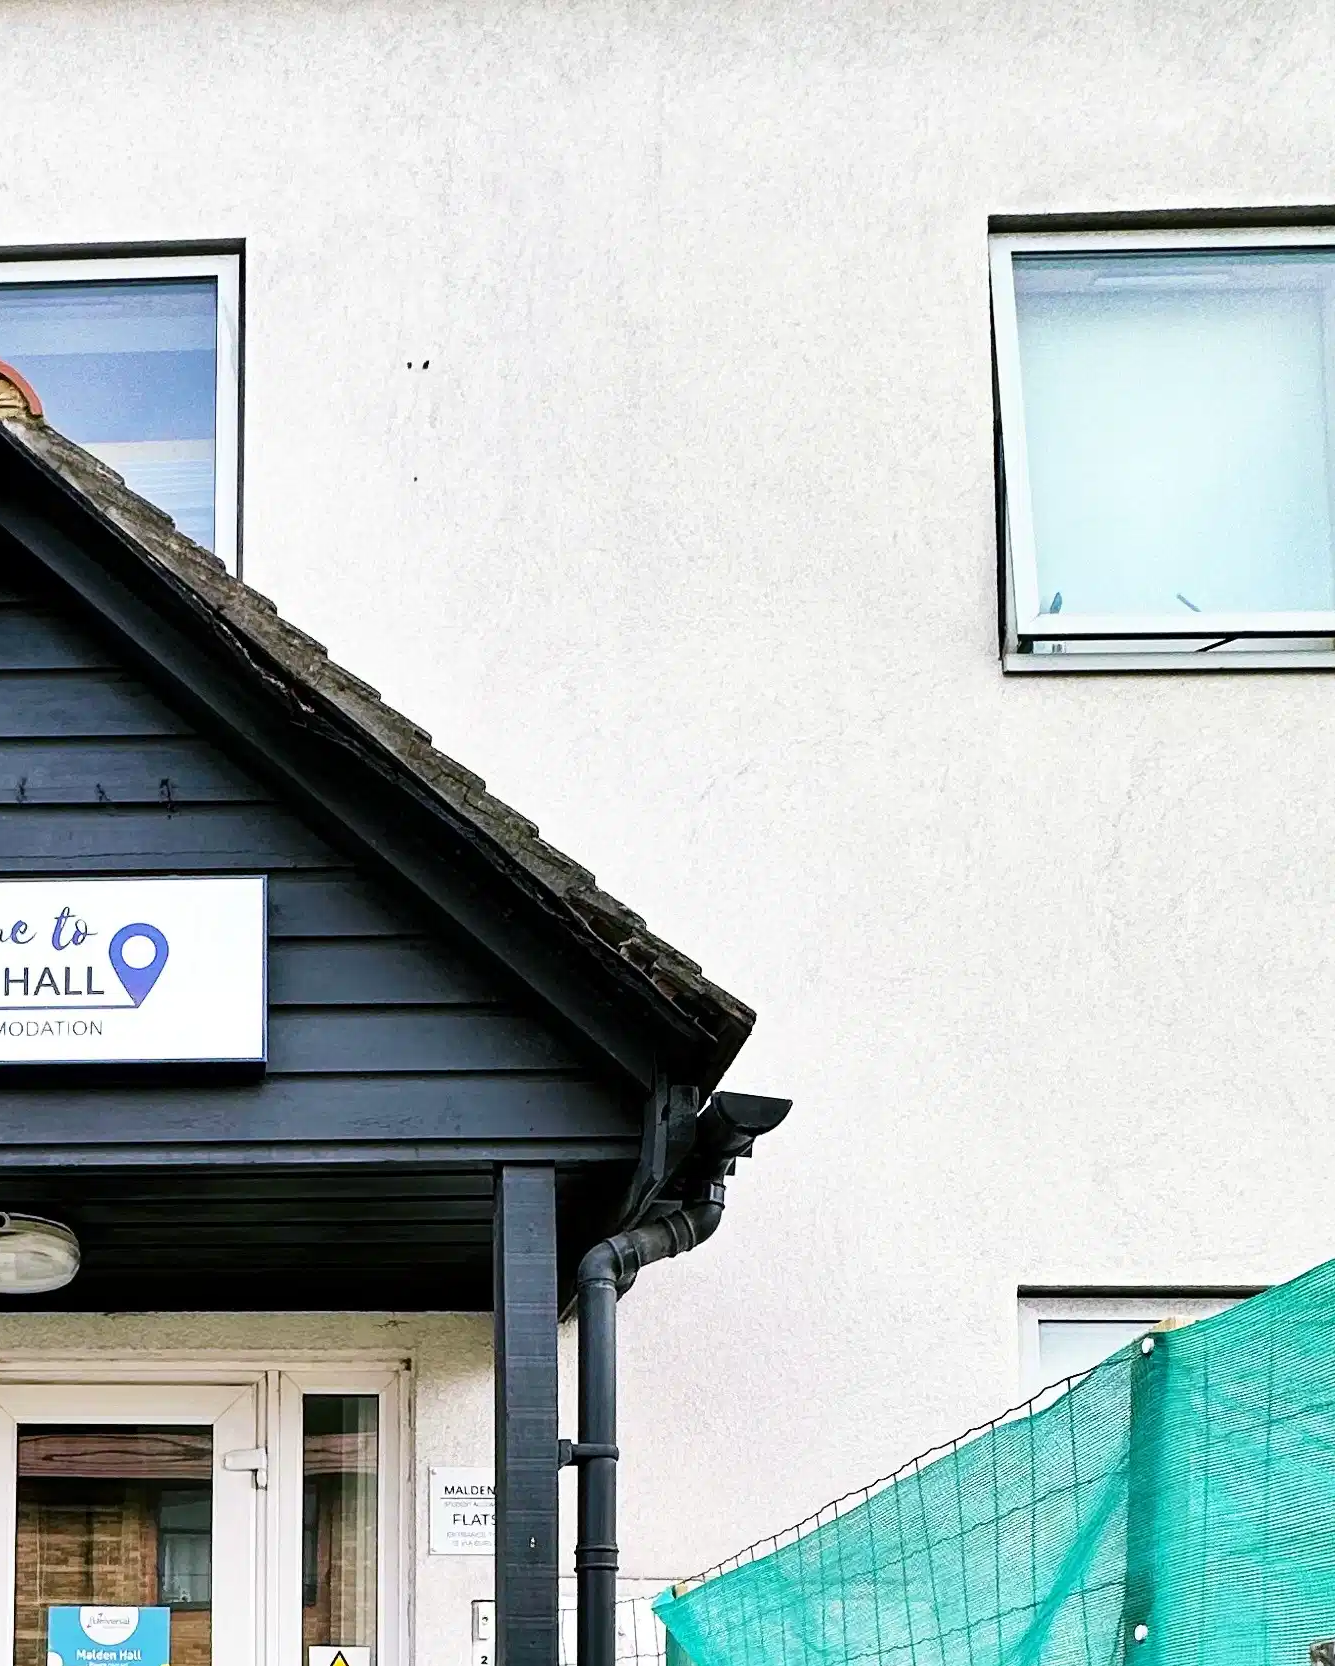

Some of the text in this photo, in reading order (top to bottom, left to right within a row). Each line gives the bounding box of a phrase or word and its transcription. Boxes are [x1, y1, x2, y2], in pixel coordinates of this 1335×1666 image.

[51, 906, 98, 951] to
[4, 965, 105, 997] HALL
[444, 1485, 495, 1496] MALDEN
[76, 1648, 142, 1661] Malden Hall
[480, 1655, 488, 1665] 2
